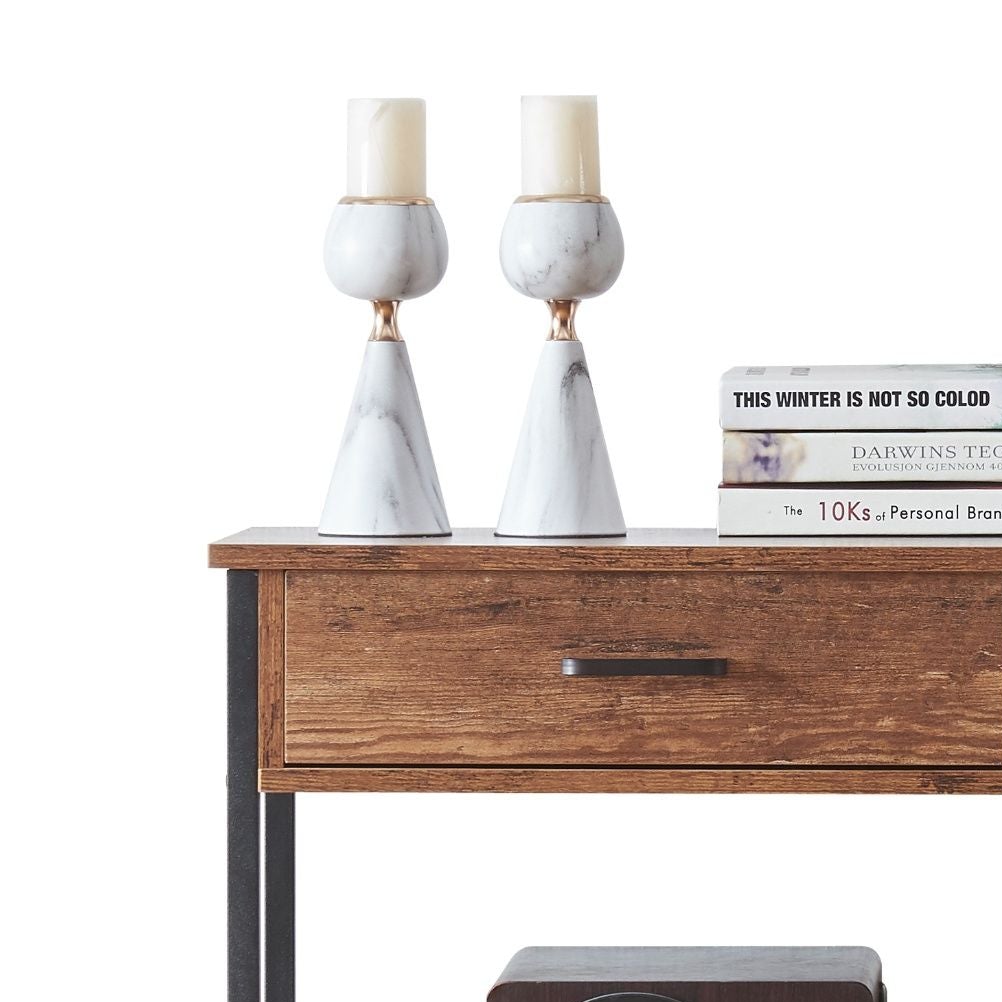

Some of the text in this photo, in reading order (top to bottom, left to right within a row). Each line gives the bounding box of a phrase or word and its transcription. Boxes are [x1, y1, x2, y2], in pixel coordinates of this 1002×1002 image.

[733, 390, 990, 408] THIS WINTER IS NOT SO COLOD
[852, 445, 956, 459] DARWINS
[852, 462, 922, 472] EVOLUSJON
[925, 462, 985, 473] GJENNOM
[784, 505, 803, 516] The
[819, 501, 871, 521] 10Ks
[876, 511, 886, 522] of
[890, 505, 959, 520] Personal
